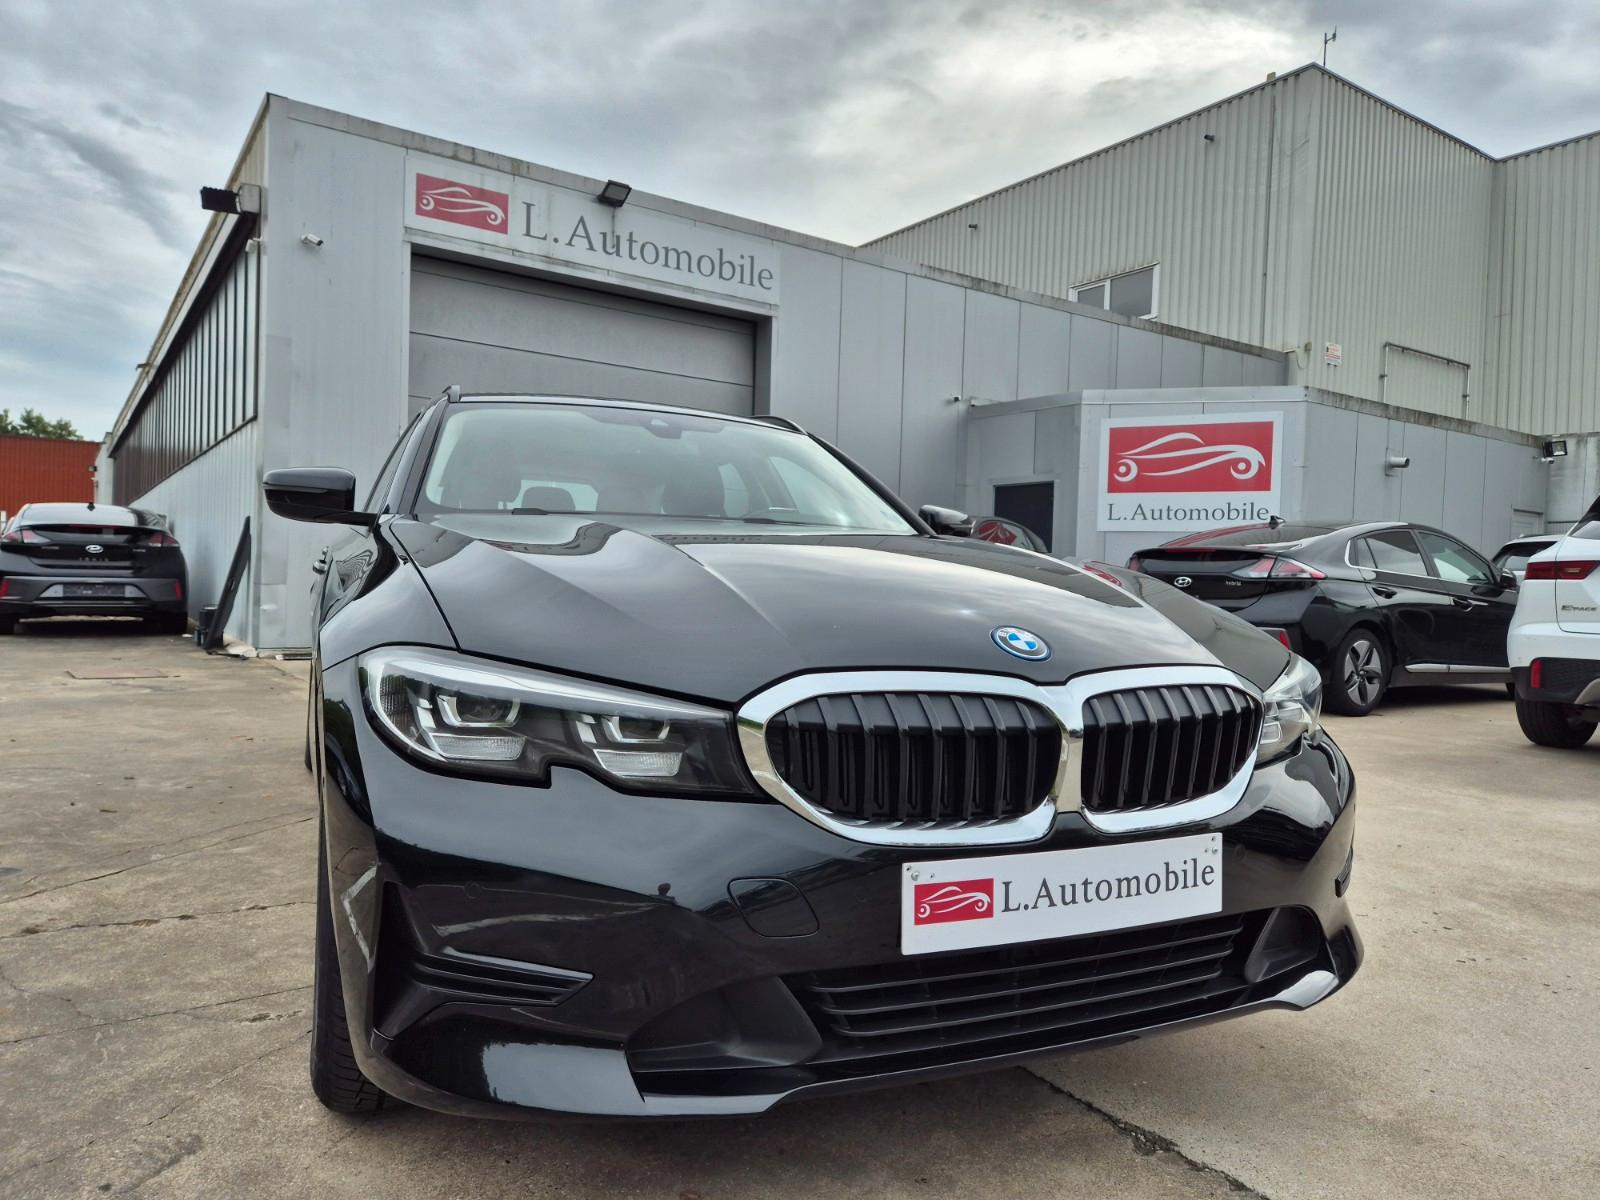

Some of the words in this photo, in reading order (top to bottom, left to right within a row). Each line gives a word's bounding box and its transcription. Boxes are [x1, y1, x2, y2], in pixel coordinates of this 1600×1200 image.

[522, 201, 774, 291] L.Automobile
[1107, 502, 1270, 521] L.Automobile
[1001, 858, 1215, 913] L.Automobile
